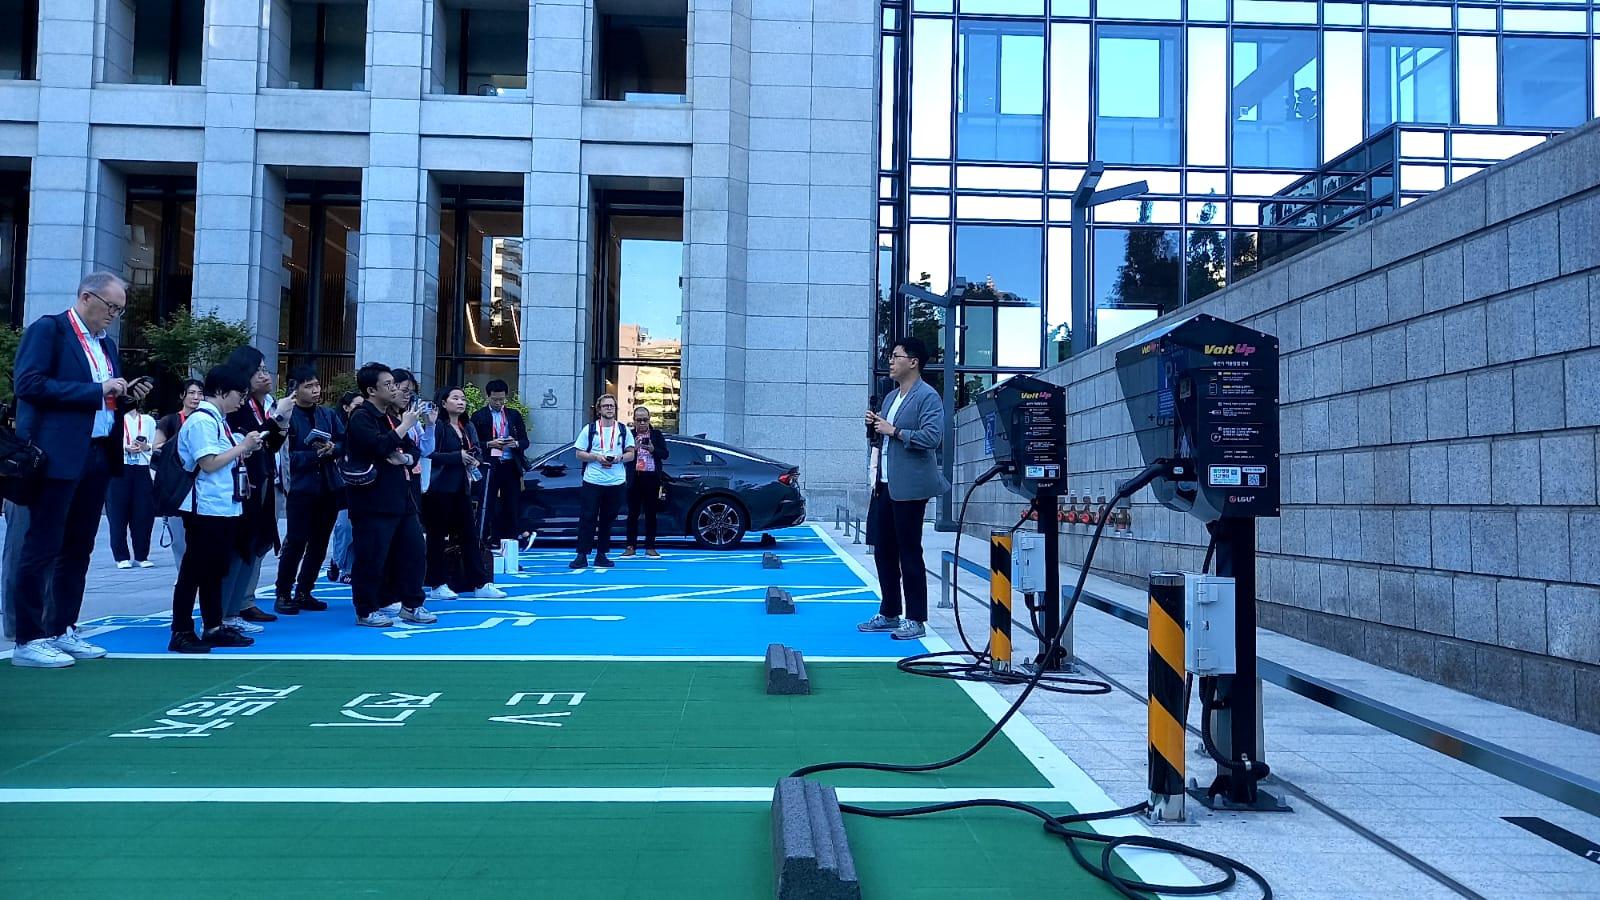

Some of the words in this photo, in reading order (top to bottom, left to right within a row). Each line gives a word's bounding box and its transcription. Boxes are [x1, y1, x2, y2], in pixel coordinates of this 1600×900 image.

[109, 686, 301, 738] 자동차
[310, 693, 442, 726] 전기
[488, 693, 586, 726] EV
